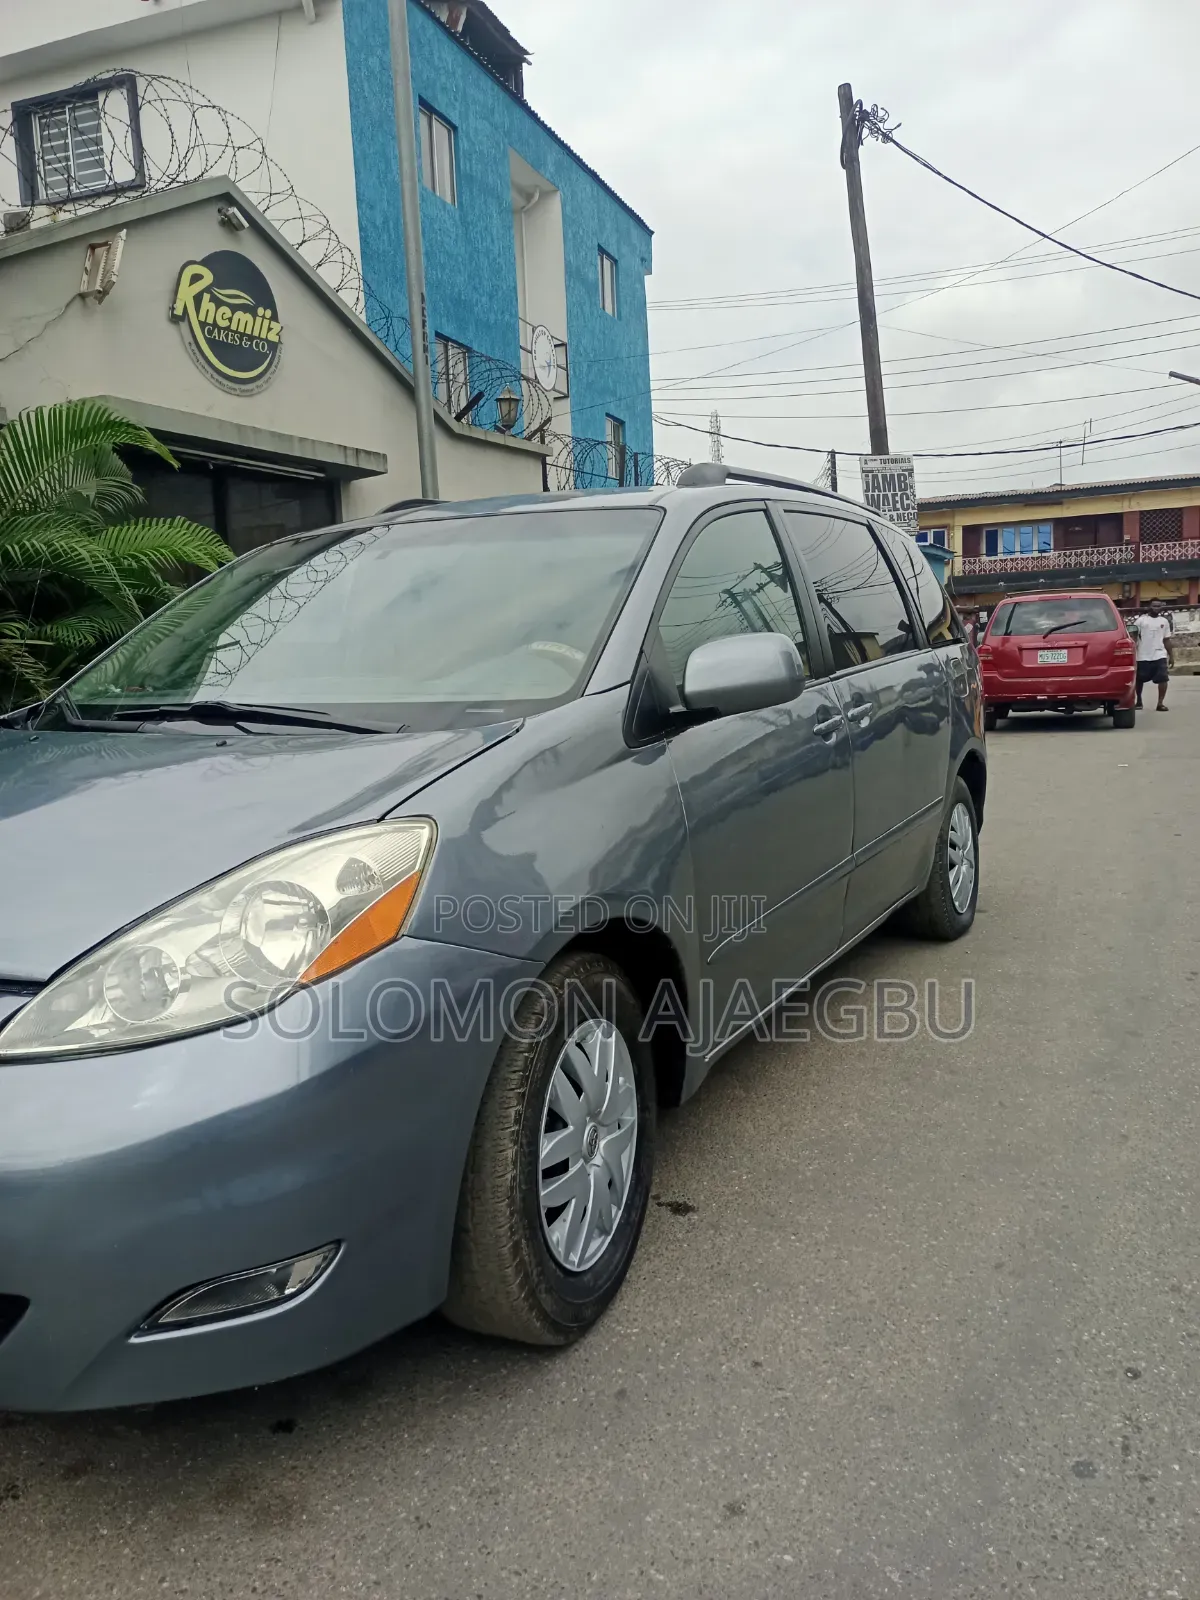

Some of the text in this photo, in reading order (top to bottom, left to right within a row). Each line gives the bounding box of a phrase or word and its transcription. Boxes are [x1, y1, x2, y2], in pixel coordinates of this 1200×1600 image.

[174, 264, 282, 343] Rhemiiz
[204, 326, 270, 354] CAKES & CO.
[879, 457, 911, 465] TUTORIALS
[864, 473, 909, 493] JAMB
[864, 493, 911, 512] WAEC
[889, 512, 918, 522] & NECO
